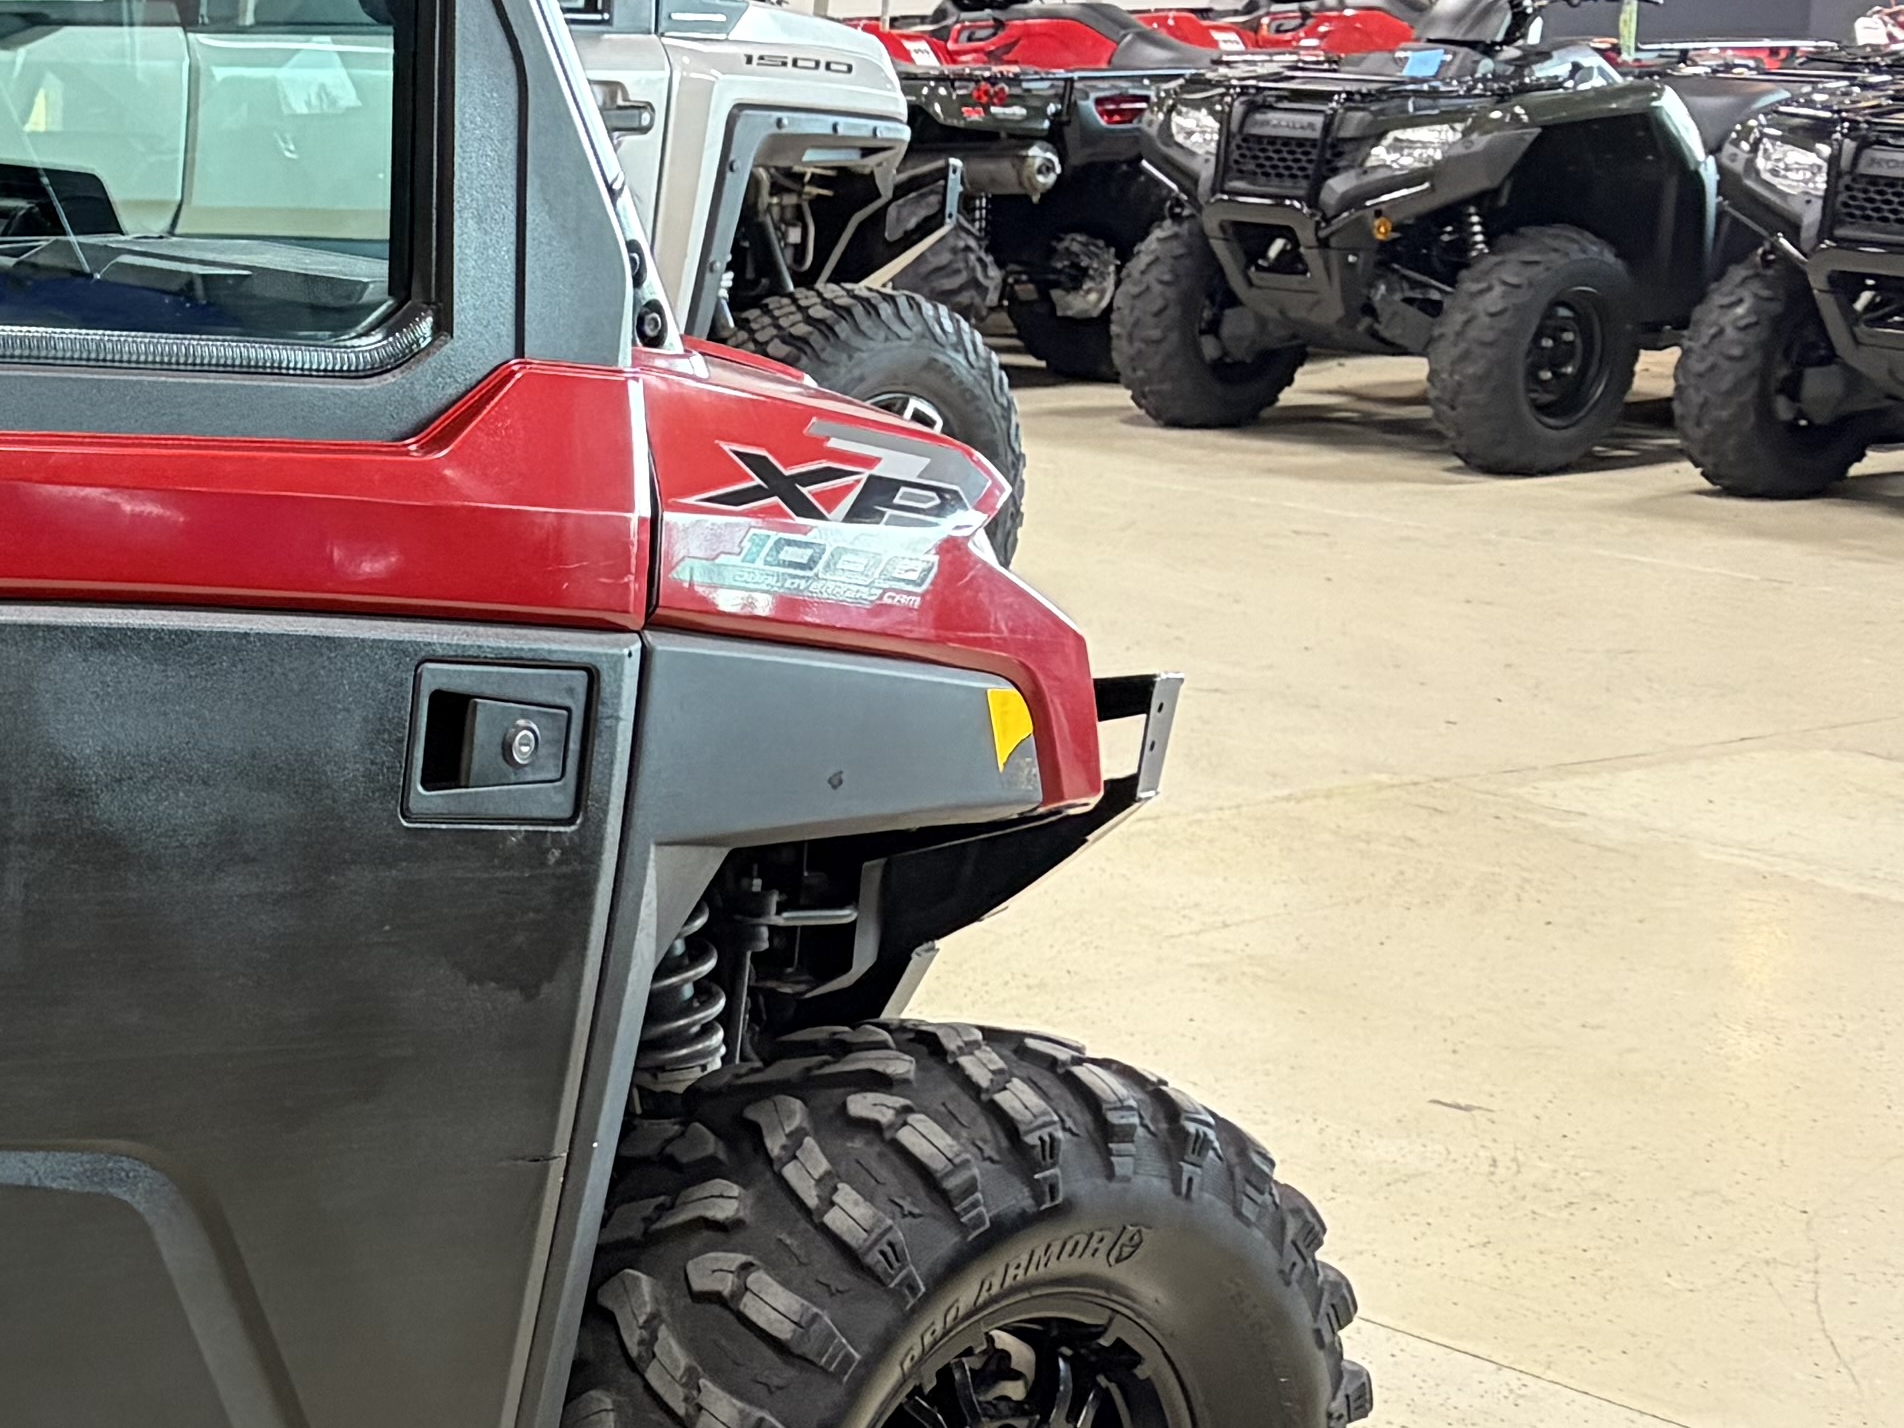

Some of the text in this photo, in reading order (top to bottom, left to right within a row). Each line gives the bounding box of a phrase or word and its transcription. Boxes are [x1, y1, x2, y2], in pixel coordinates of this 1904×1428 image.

[743, 53, 854, 74] 1500
[682, 444, 974, 524] XP
[739, 529, 939, 592] 1000
[882, 591, 921, 609] CAM
[900, 1228, 1115, 1379] PRO ARMOR
